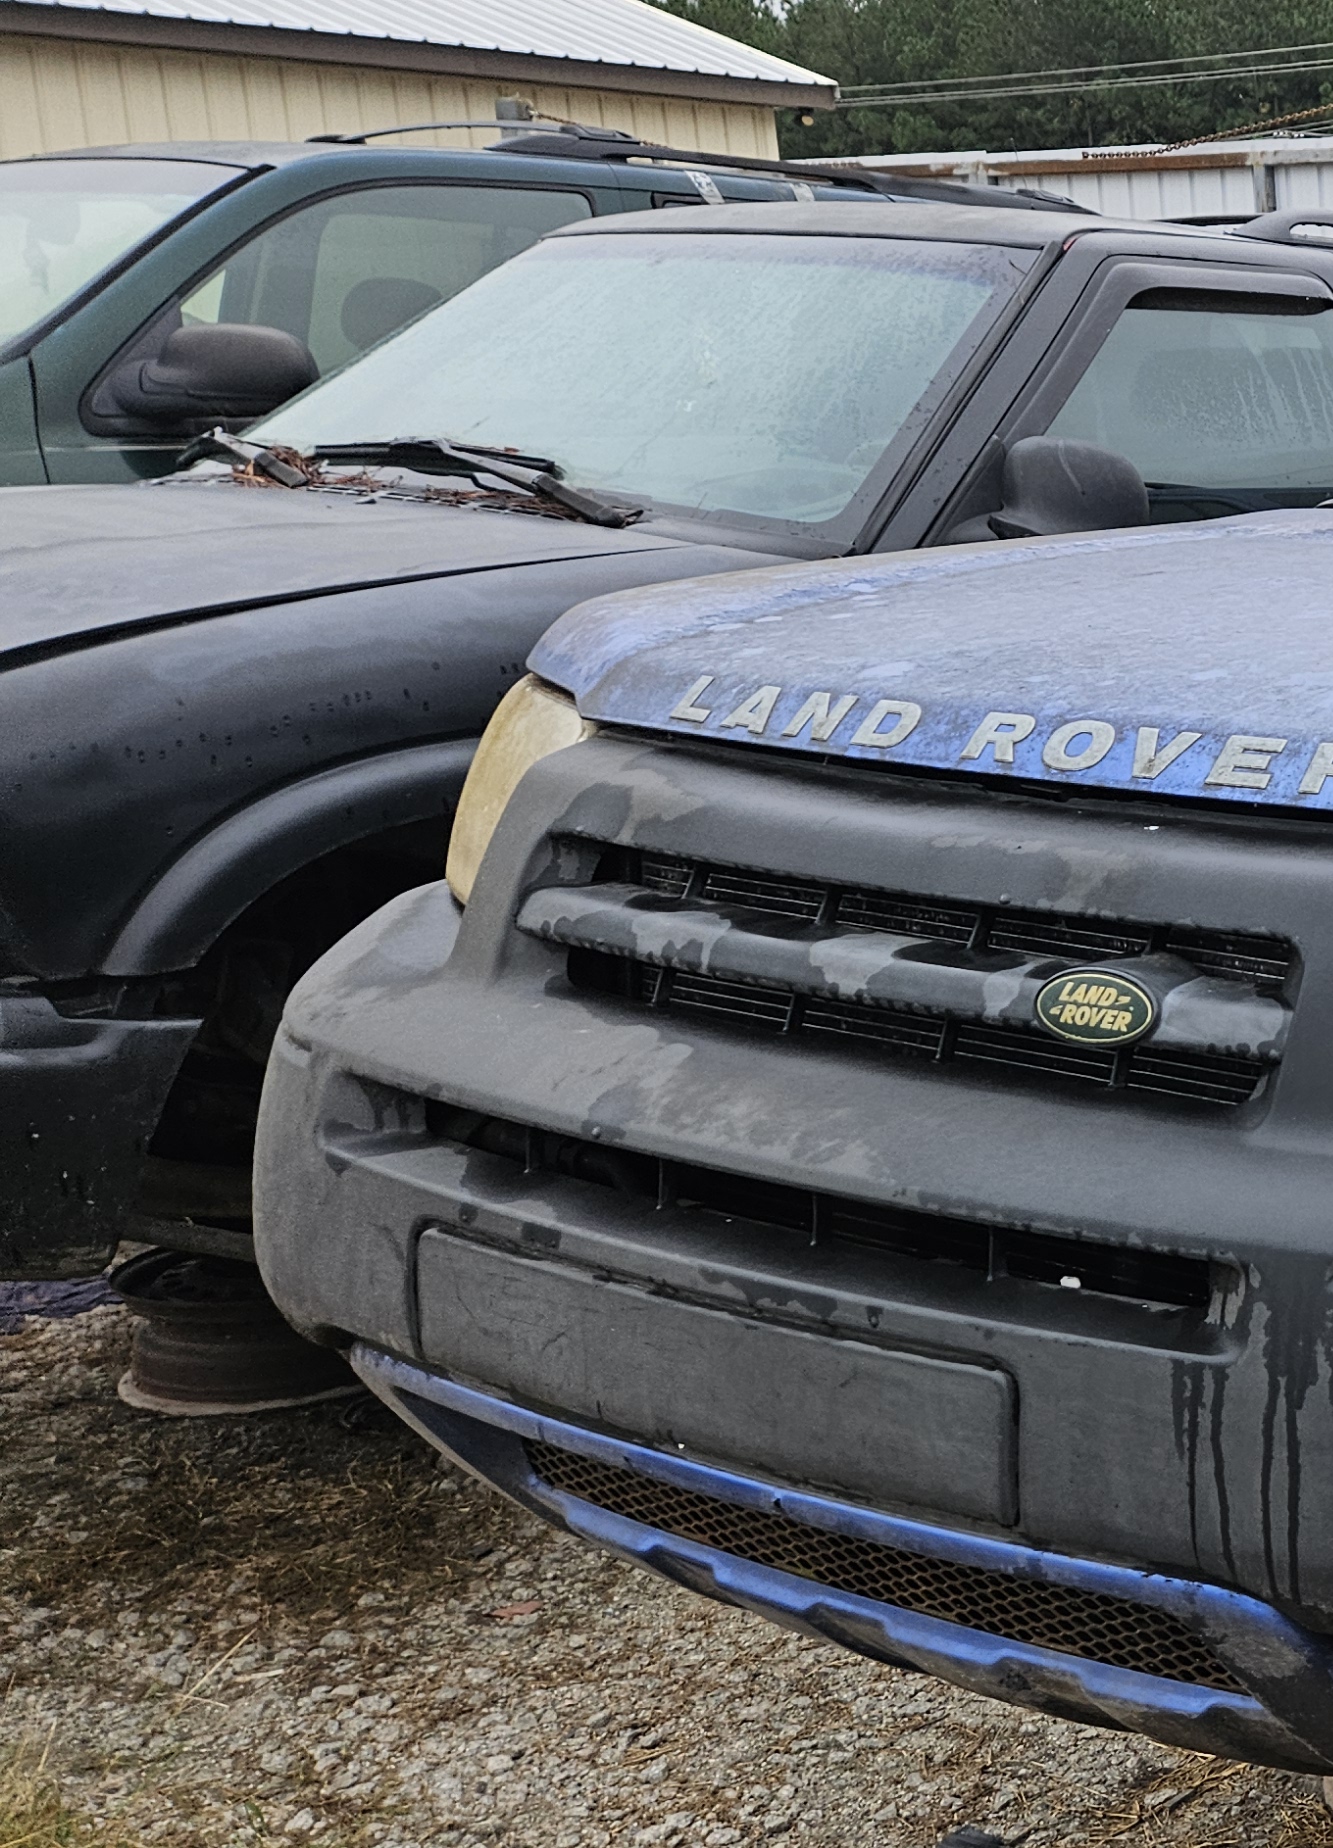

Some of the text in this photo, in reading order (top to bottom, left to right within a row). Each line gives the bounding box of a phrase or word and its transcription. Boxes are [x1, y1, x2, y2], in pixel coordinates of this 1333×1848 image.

[669, 674, 922, 749] LAND
[1058, 981, 1118, 1006] LAND
[1059, 1004, 1132, 1032] ROVER
